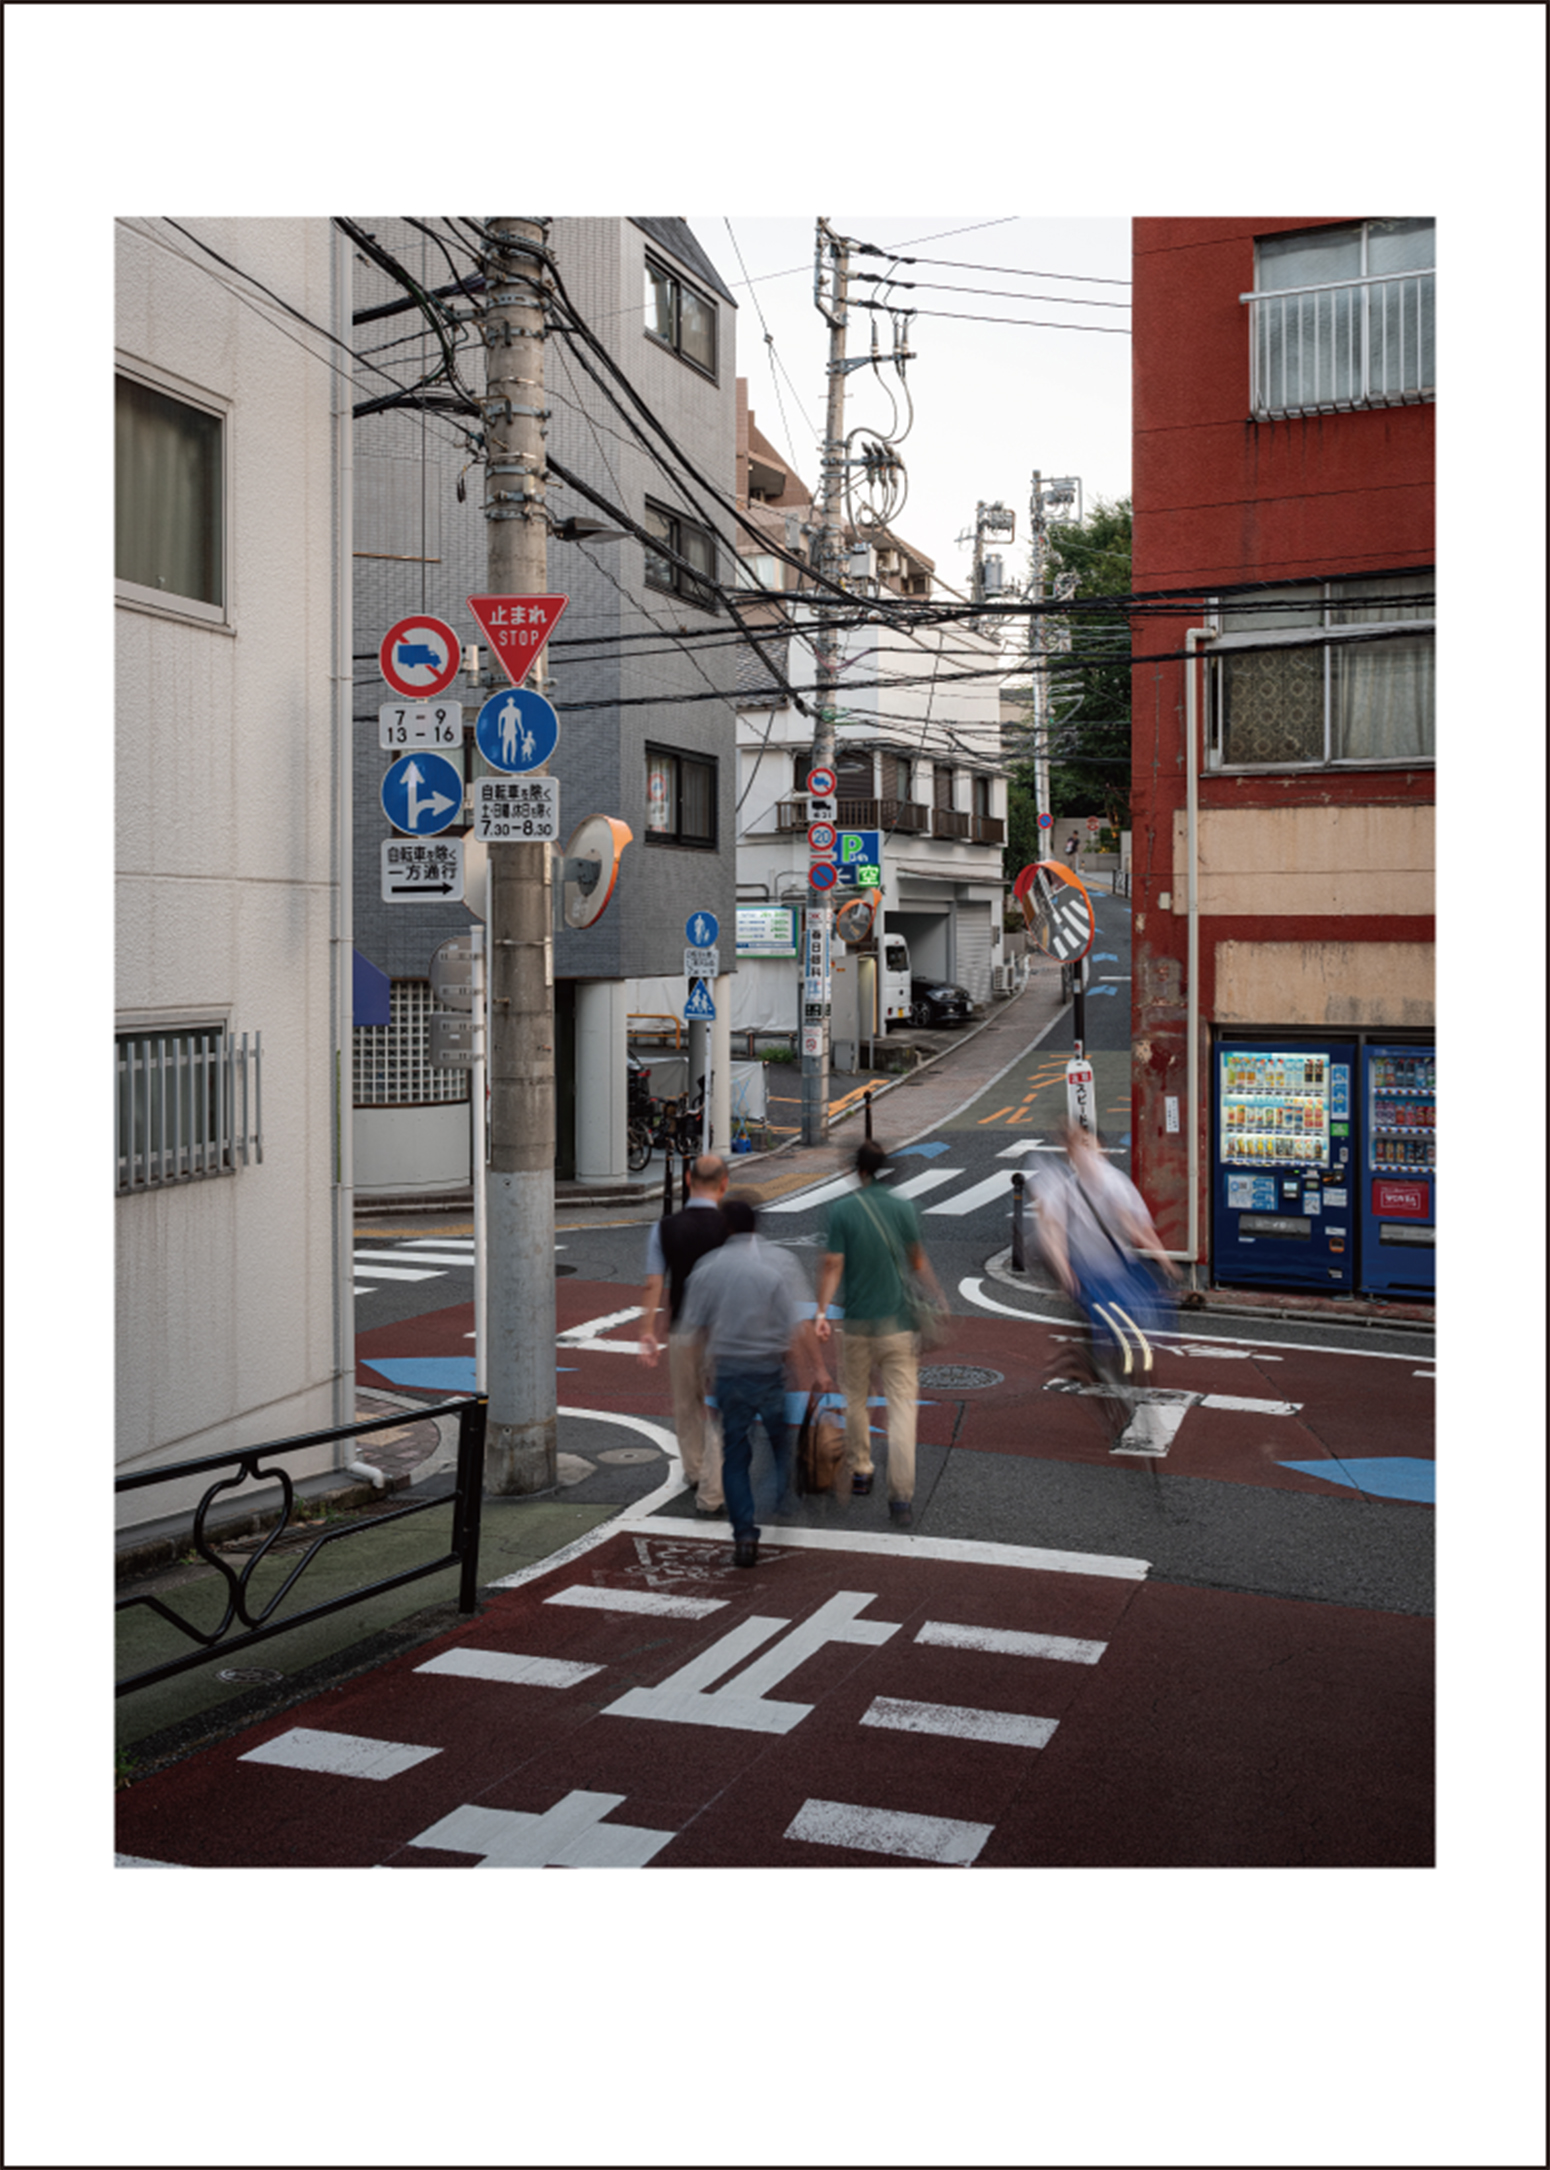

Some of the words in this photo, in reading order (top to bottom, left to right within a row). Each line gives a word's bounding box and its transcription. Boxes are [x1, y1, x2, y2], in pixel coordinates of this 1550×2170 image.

[489, 605, 547, 626] 止まれ
[498, 630, 540, 647] STOP
[395, 710, 406, 726] 7
[434, 709, 447, 725] 9
[387, 727, 408, 743] 13
[434, 726, 455, 742] 16
[482, 784, 552, 801] 自転車を除く
[813, 830, 832, 844] 20
[387, 846, 457, 863] 自転車を除く
[842, 834, 864, 863] P
[388, 864, 458, 881] 一方通行
[859, 864, 879, 886] 空
